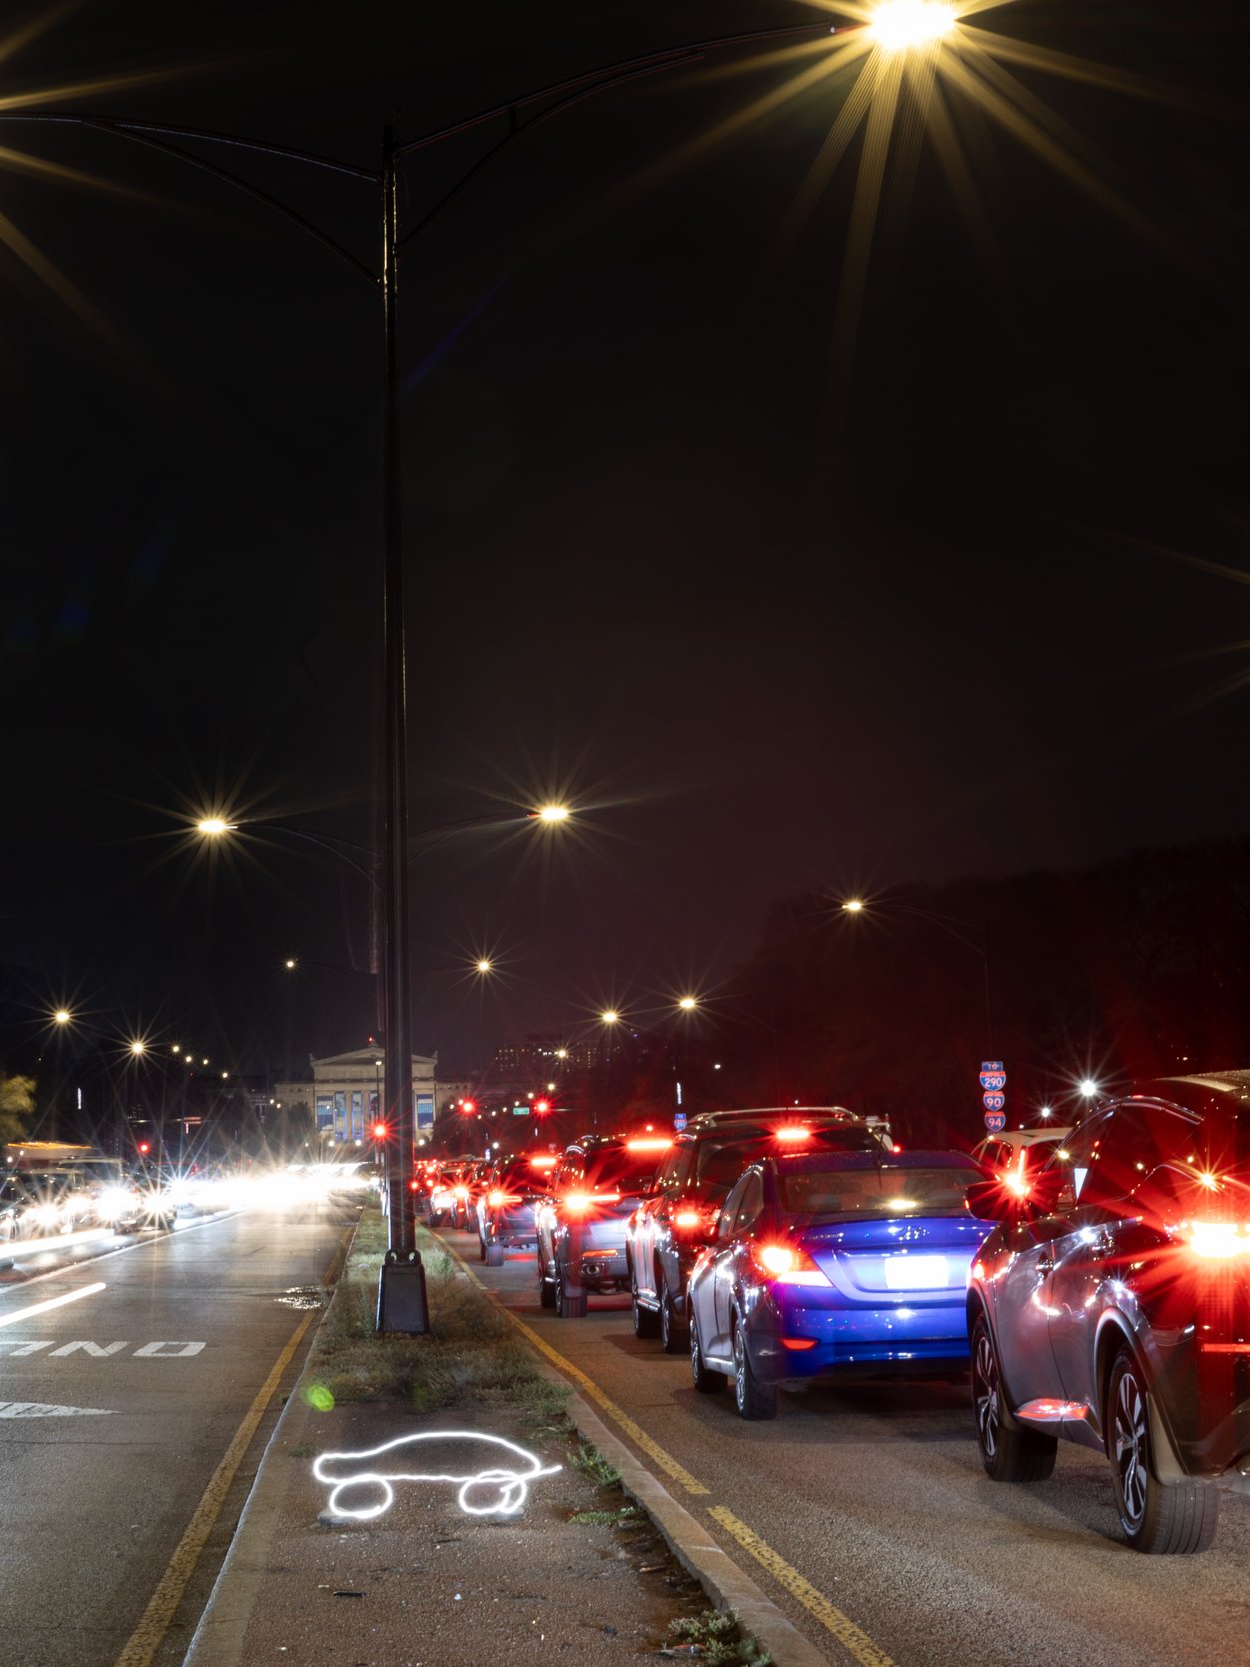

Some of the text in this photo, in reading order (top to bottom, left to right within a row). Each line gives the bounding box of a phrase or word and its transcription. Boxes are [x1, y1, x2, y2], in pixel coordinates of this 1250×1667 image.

[985, 1077, 1002, 1087] 290
[987, 1097, 1001, 1107] 90
[988, 1117, 1001, 1127] 94
